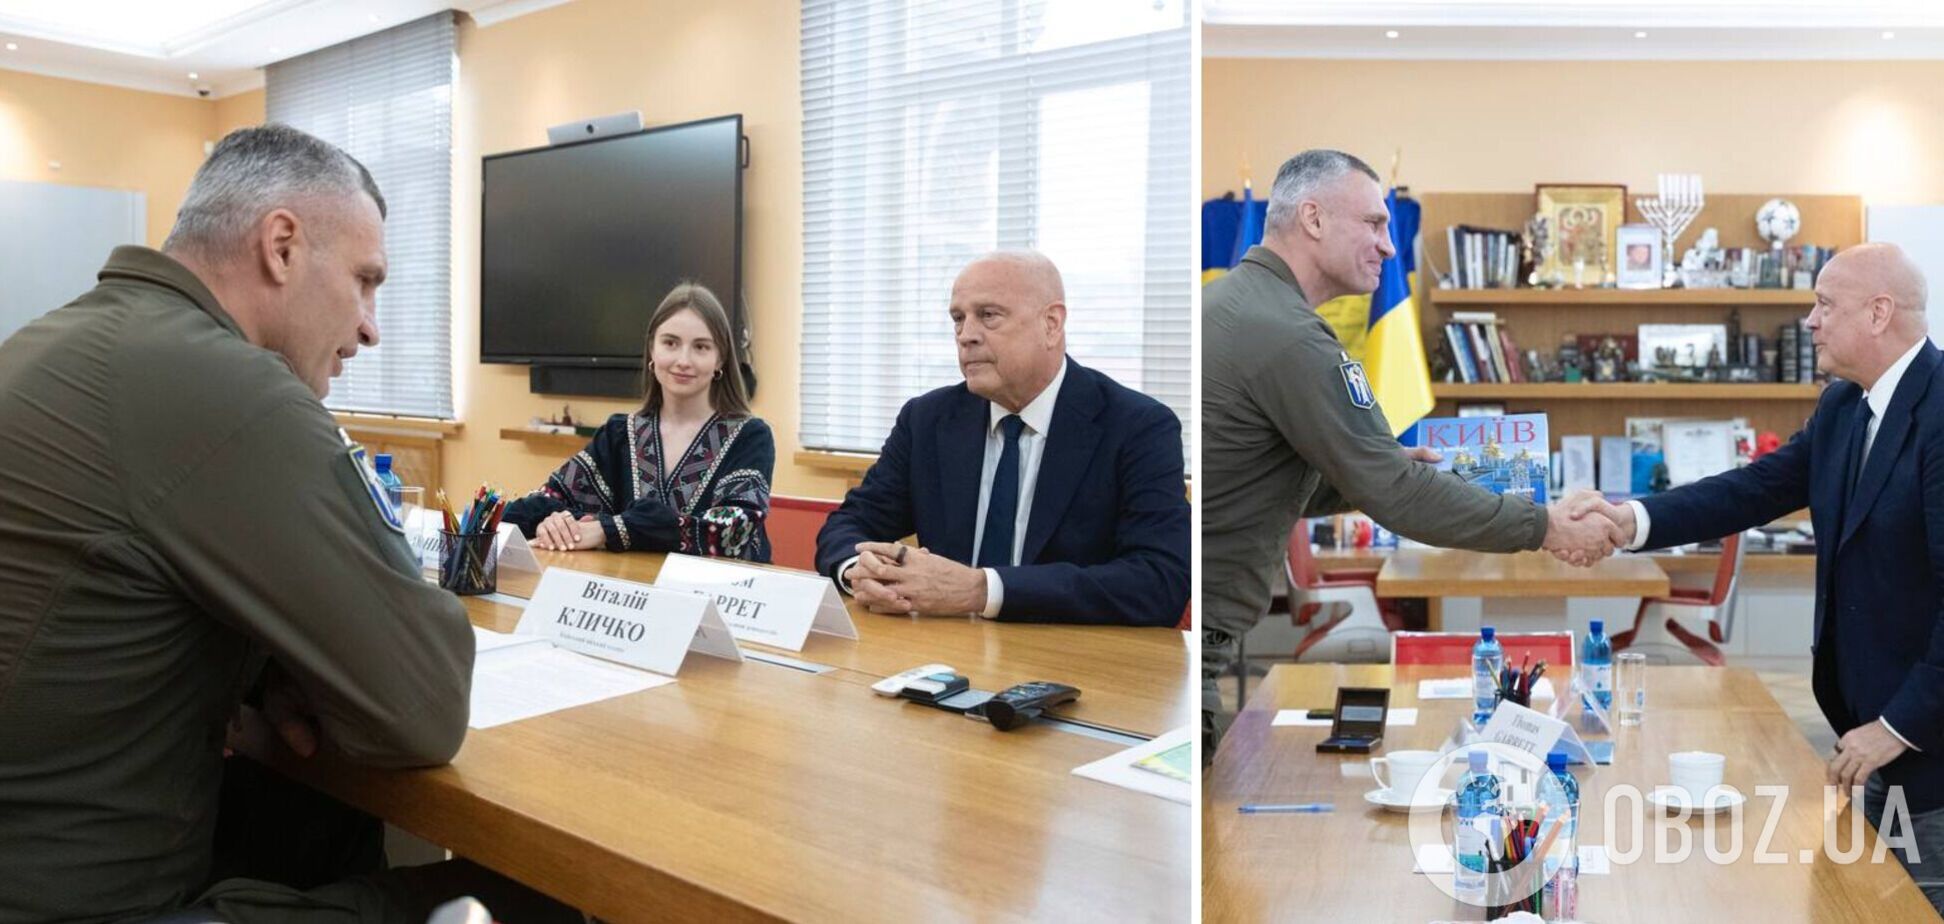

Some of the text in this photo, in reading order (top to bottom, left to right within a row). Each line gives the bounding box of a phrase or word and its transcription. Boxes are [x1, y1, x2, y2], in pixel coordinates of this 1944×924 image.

[1426, 417, 1536, 448] КИЇВ
[581, 580, 650, 611] Віталій
[693, 590, 767, 619] РРЕТ
[557, 606, 646, 642] КЛИЧКО
